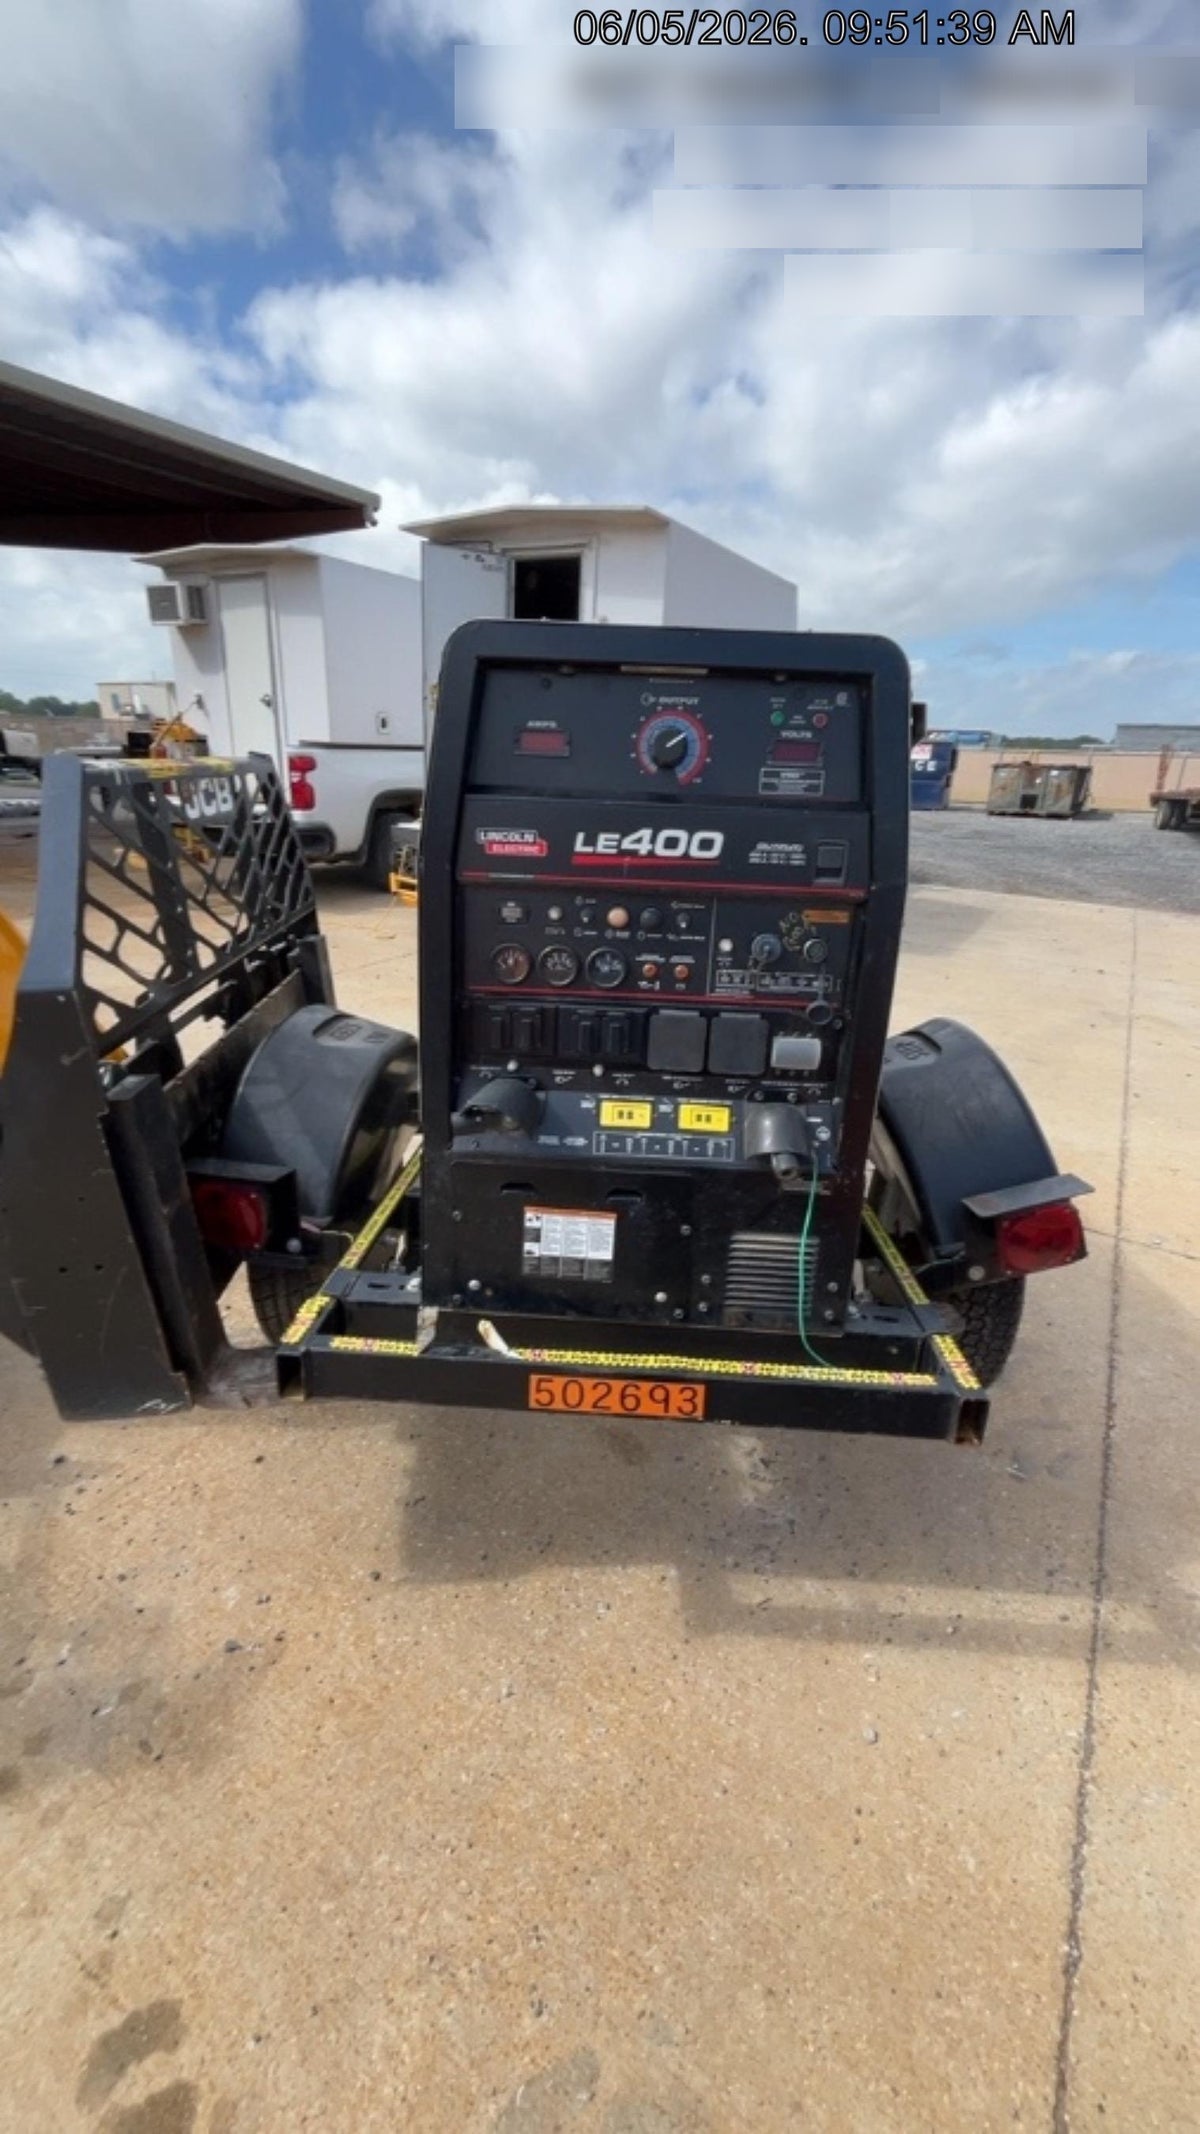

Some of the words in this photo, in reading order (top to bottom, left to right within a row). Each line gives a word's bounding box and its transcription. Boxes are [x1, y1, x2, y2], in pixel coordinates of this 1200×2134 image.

[184, 777, 233, 819] JCB
[480, 831, 536, 843] LINCOLN
[491, 844, 541, 854] ELECTRIC
[573, 827, 725, 859] LE400
[534, 1377, 700, 1416] 502693
